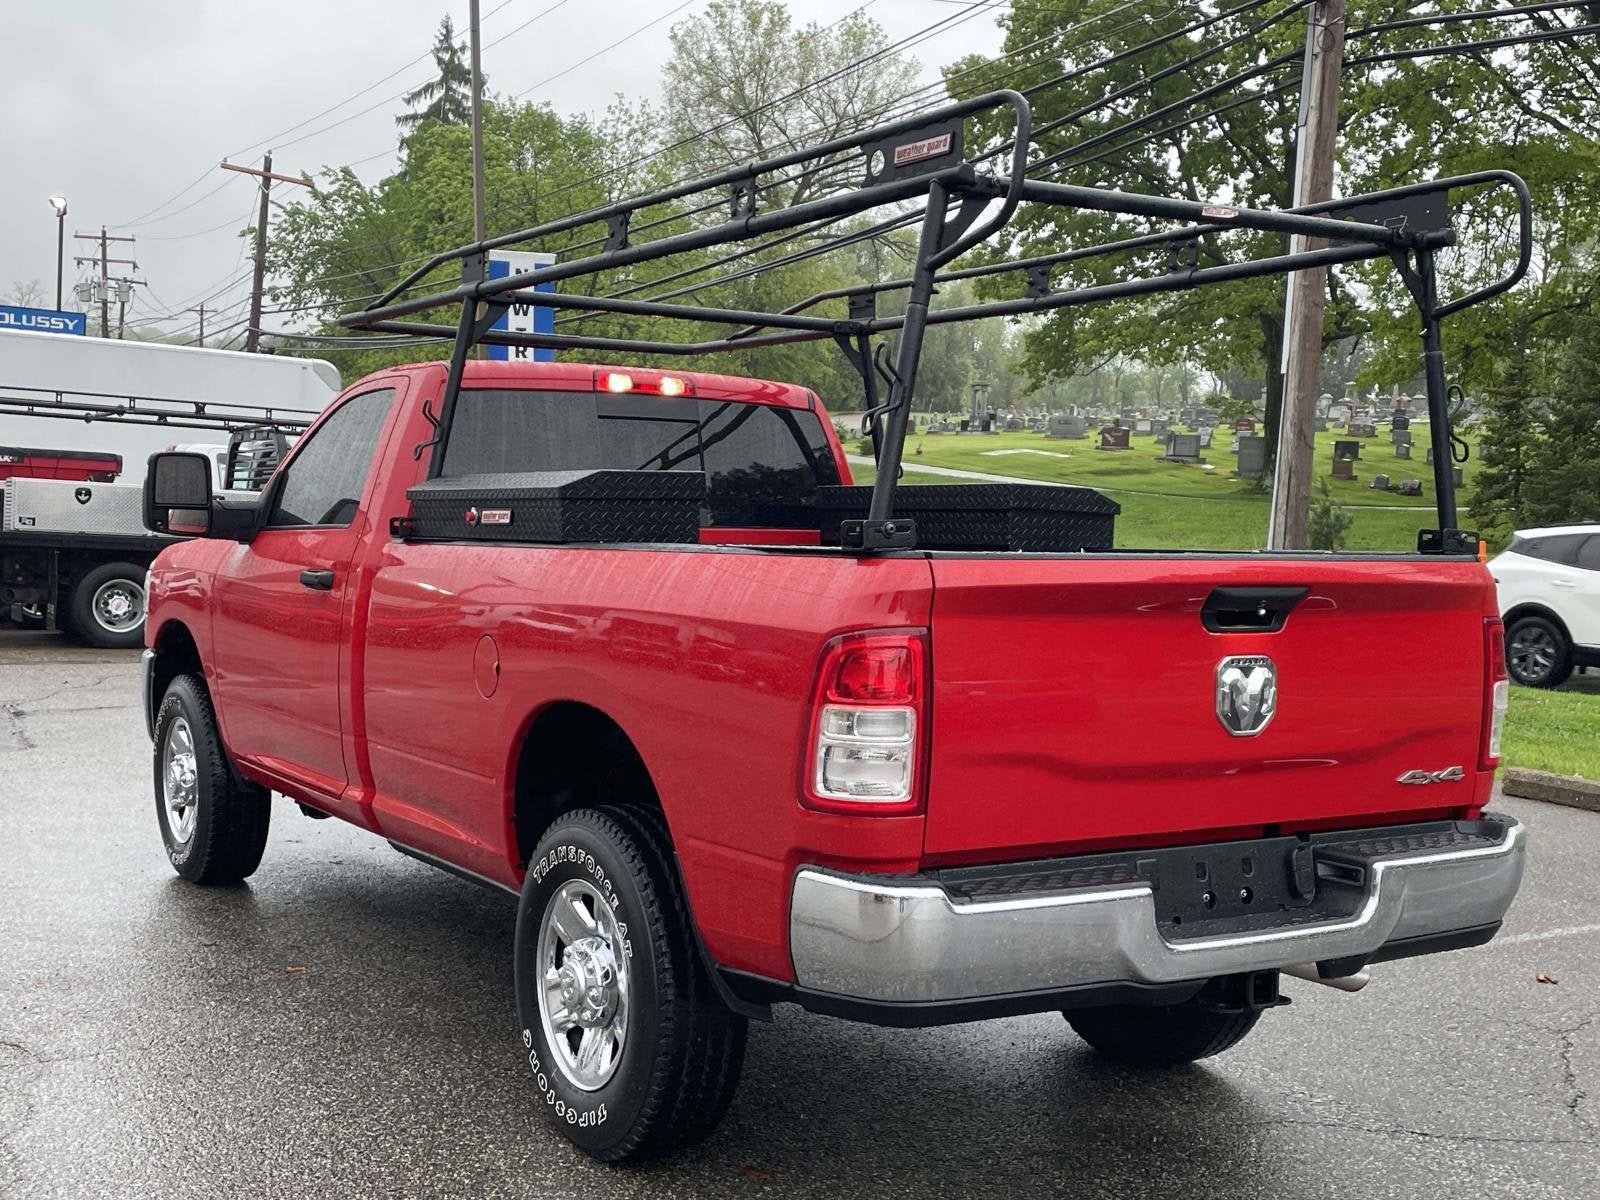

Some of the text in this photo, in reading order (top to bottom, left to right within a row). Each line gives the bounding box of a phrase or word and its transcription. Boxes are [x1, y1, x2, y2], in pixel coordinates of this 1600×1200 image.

[926, 136, 948, 154] guard
[1396, 766, 1465, 784] 4x4
[533, 846, 633, 957] TRANSFORCE AT
